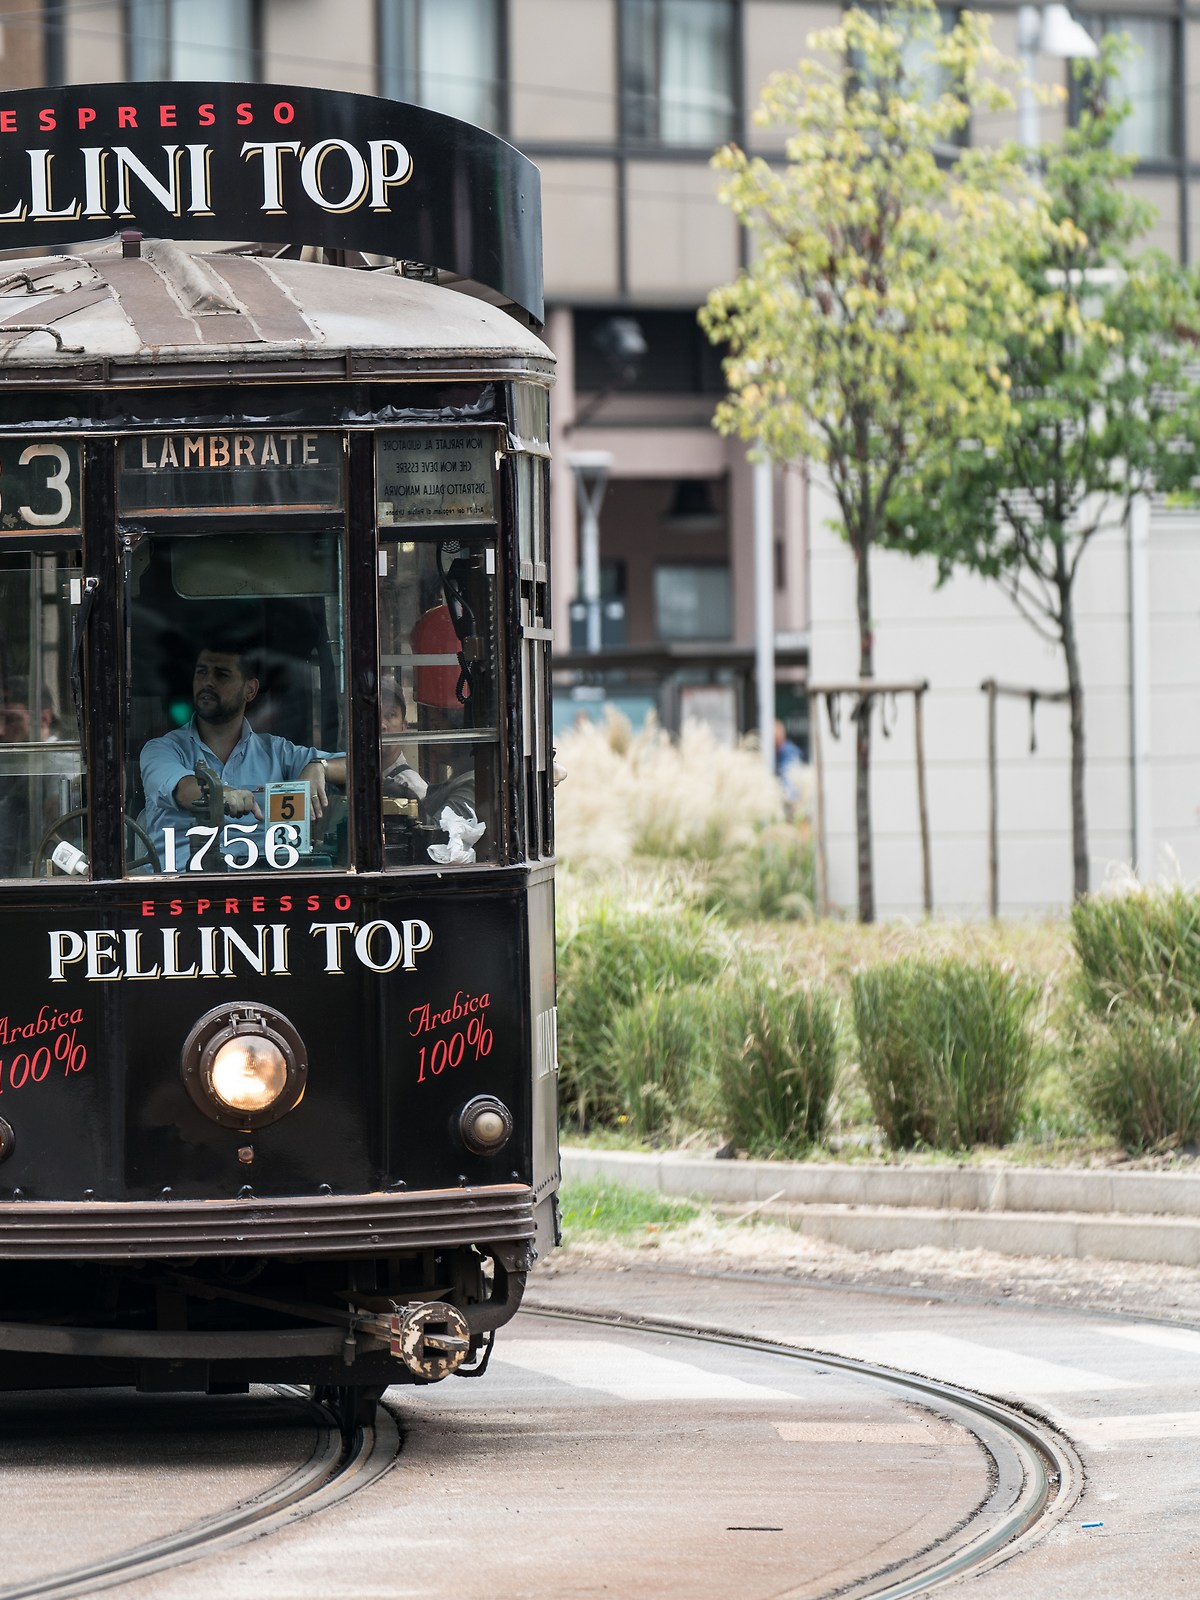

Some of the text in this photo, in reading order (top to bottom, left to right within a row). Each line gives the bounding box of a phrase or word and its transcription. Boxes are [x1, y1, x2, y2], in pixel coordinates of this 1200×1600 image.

[0, 102, 295, 132] ESPRESSO
[240, 138, 414, 214] TOP
[141, 433, 320, 469] LAMBRATE
[281, 795, 295, 820] 5
[162, 824, 300, 873] 1756
[142, 894, 351, 916] ESPRESSO
[48, 919, 434, 982] PELLINI TOP
[408, 991, 490, 1037] Arabica
[417, 1013, 494, 1083] 100%
